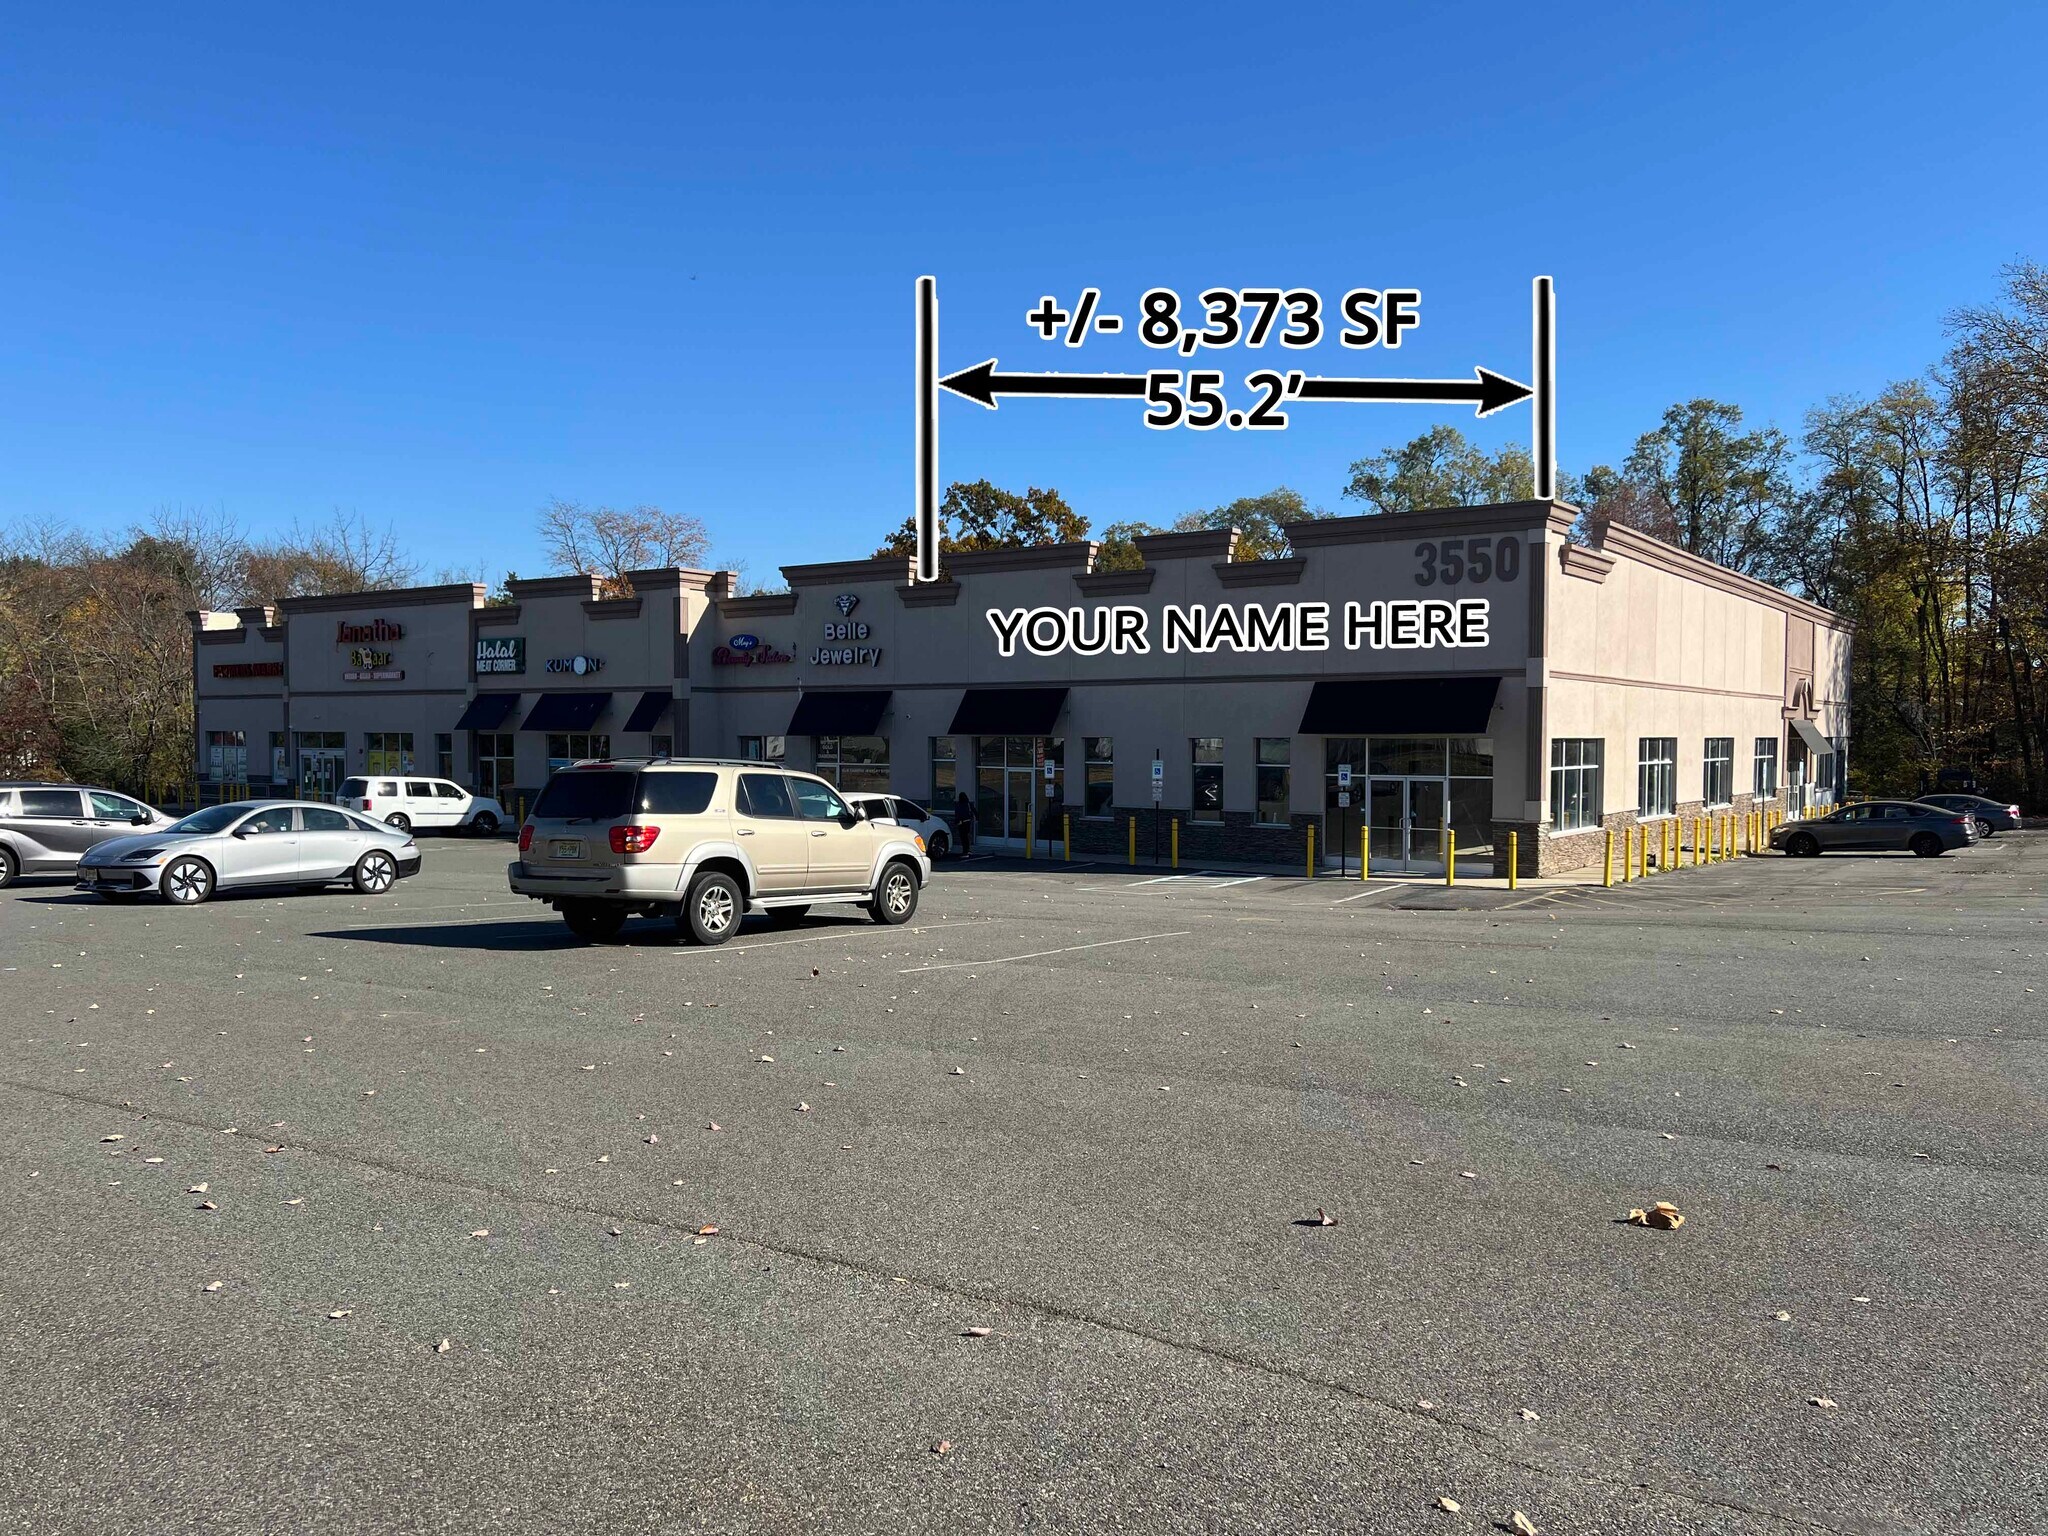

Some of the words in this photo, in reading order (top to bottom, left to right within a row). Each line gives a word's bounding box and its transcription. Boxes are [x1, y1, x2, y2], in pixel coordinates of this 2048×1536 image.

[1414, 536, 1520, 588] 3550
[336, 618, 403, 643] Janatha
[824, 622, 869, 641] Belle
[476, 640, 516, 660] Halal
[810, 647, 881, 668] Jewelry
[476, 660, 492, 673] MEAT
[493, 659, 516, 672] CORNER
[545, 656, 600, 676] KUMON
